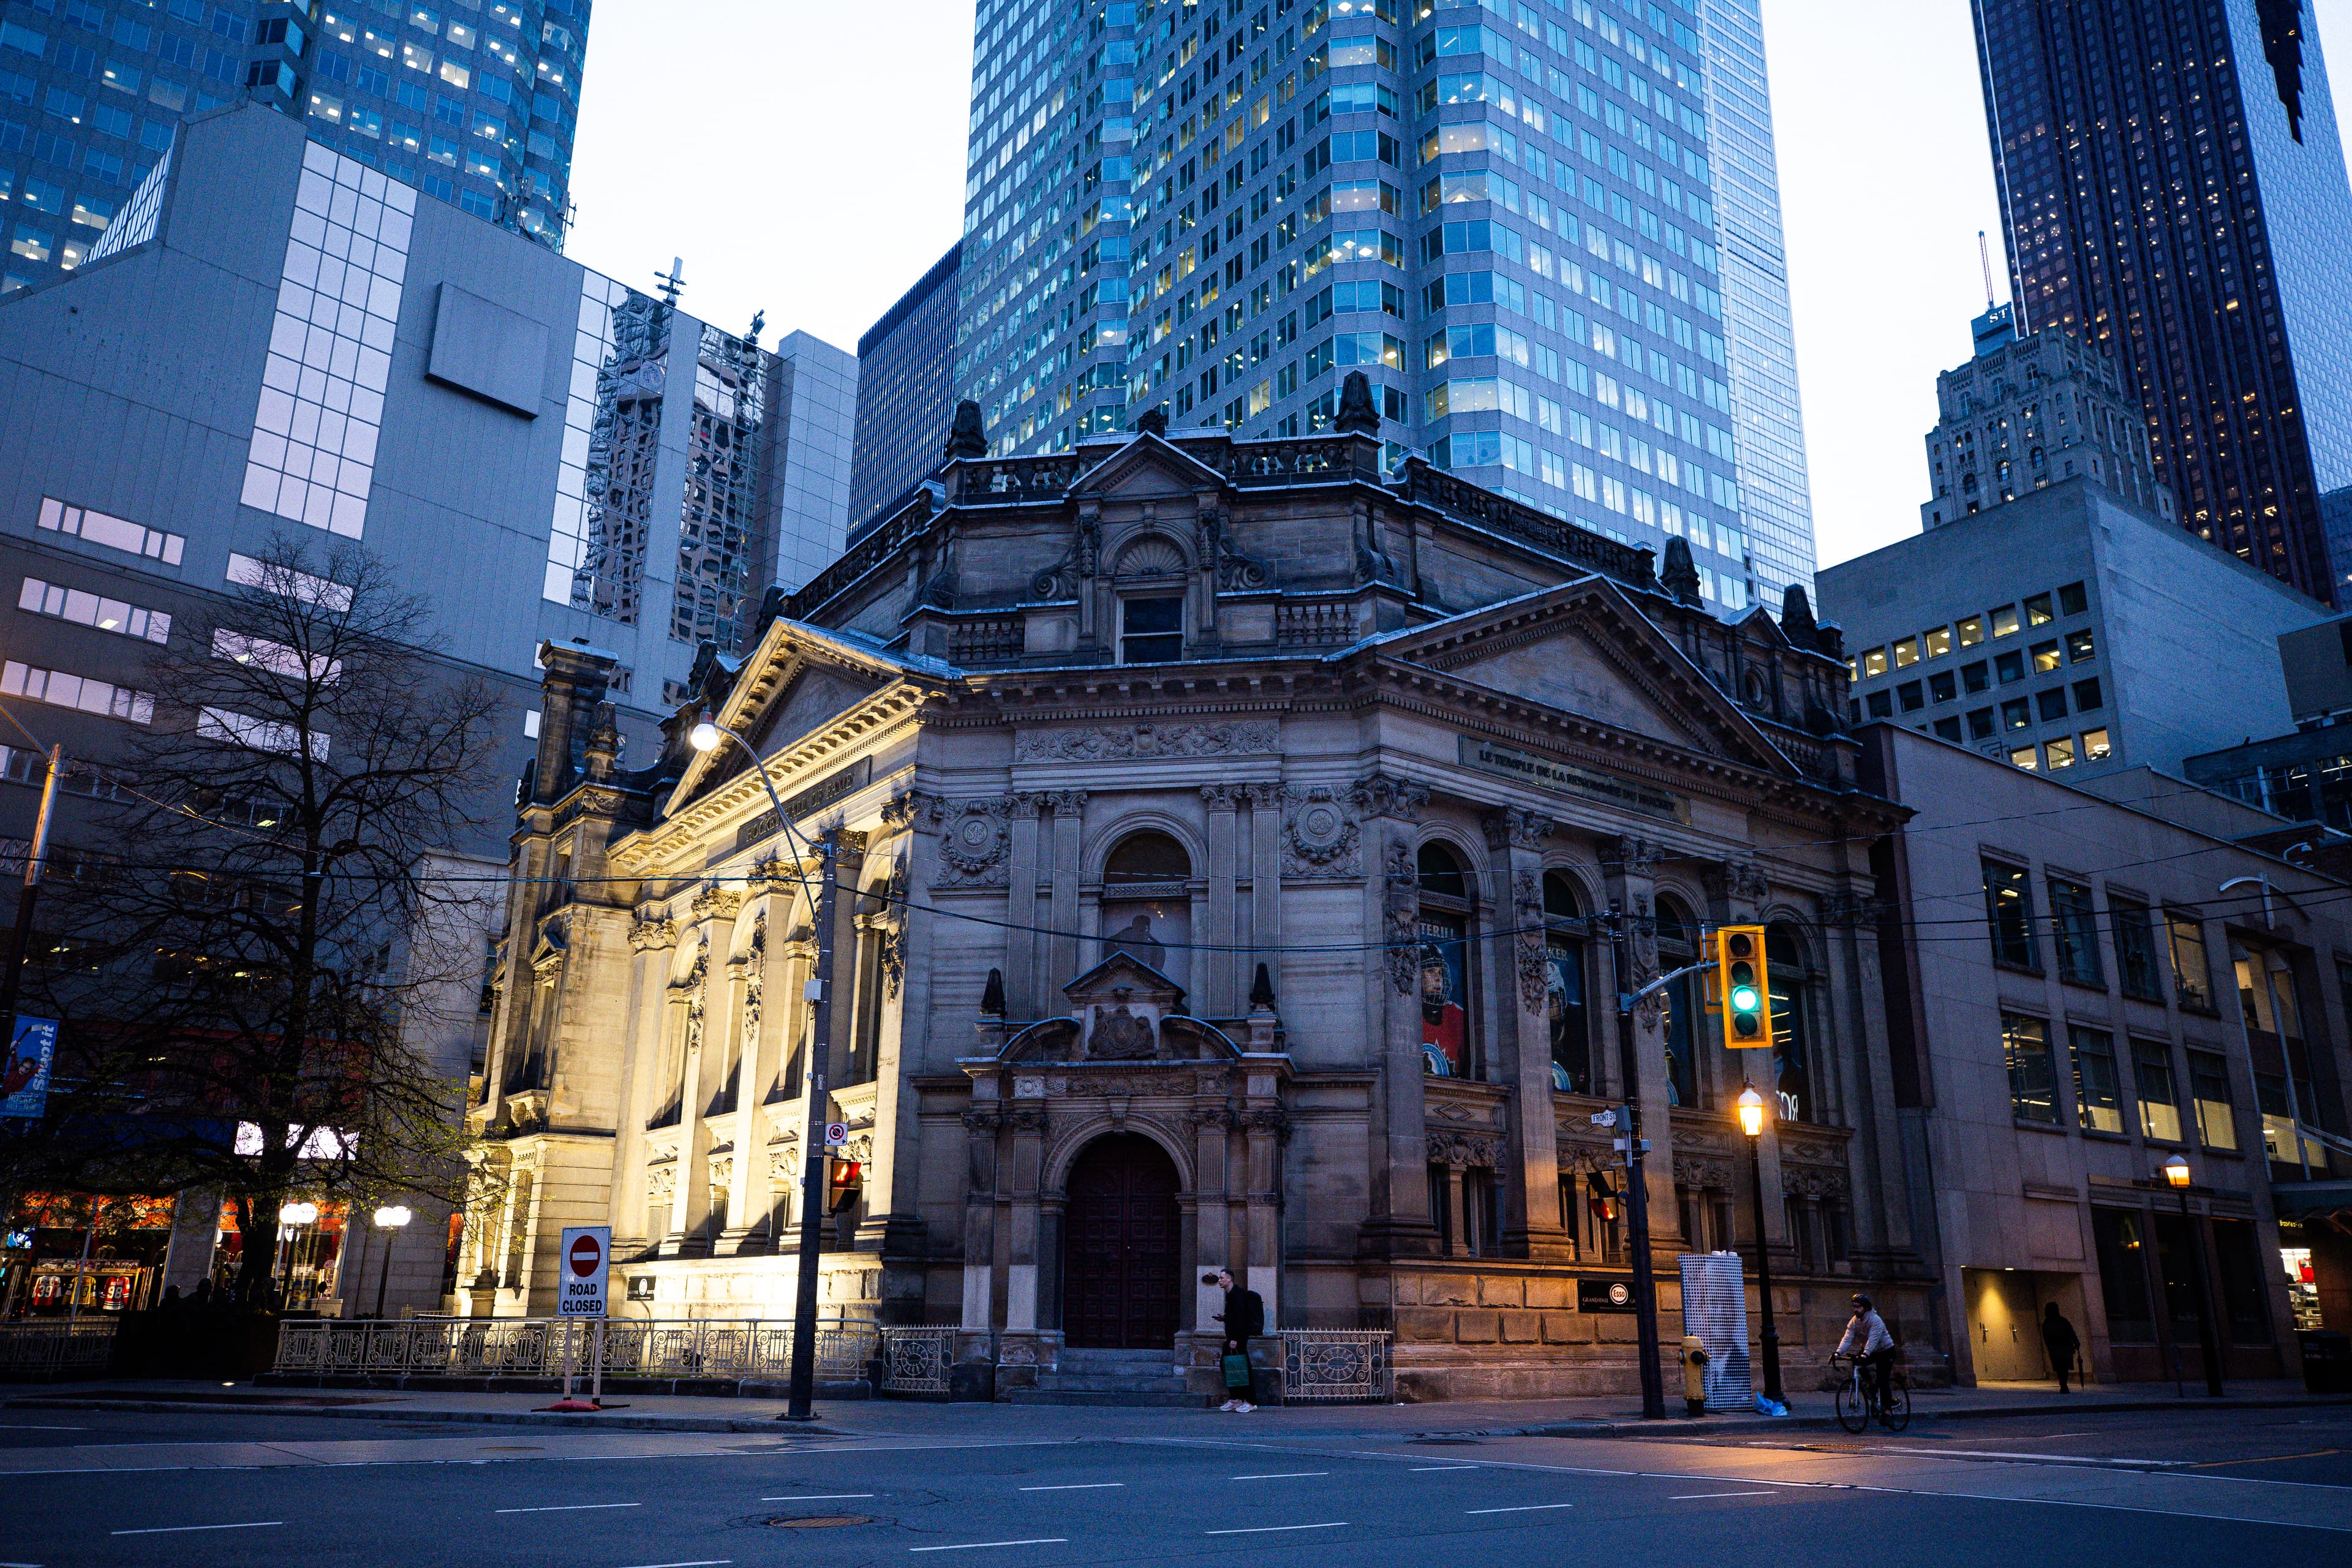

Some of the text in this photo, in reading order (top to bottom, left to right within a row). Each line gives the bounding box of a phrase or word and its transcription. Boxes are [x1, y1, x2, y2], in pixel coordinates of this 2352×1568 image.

[1989, 307, 2008, 323] ST
[1479, 750, 1492, 763] LE
[1494, 753, 1535, 774] TEMPLE
[1537, 765, 1551, 778] DE
[1553, 769, 1566, 782] LA
[810, 788, 824, 807] OF
[826, 772, 854, 800] FAME
[42, 1024, 55, 1038] it
[1593, 1114, 1608, 1122] FRONT
[38, 1285, 54, 1298] 39
[107, 1286, 123, 1298] 98
[569, 1283, 597, 1295] ROAD
[562, 1300, 602, 1312] CLOSED
